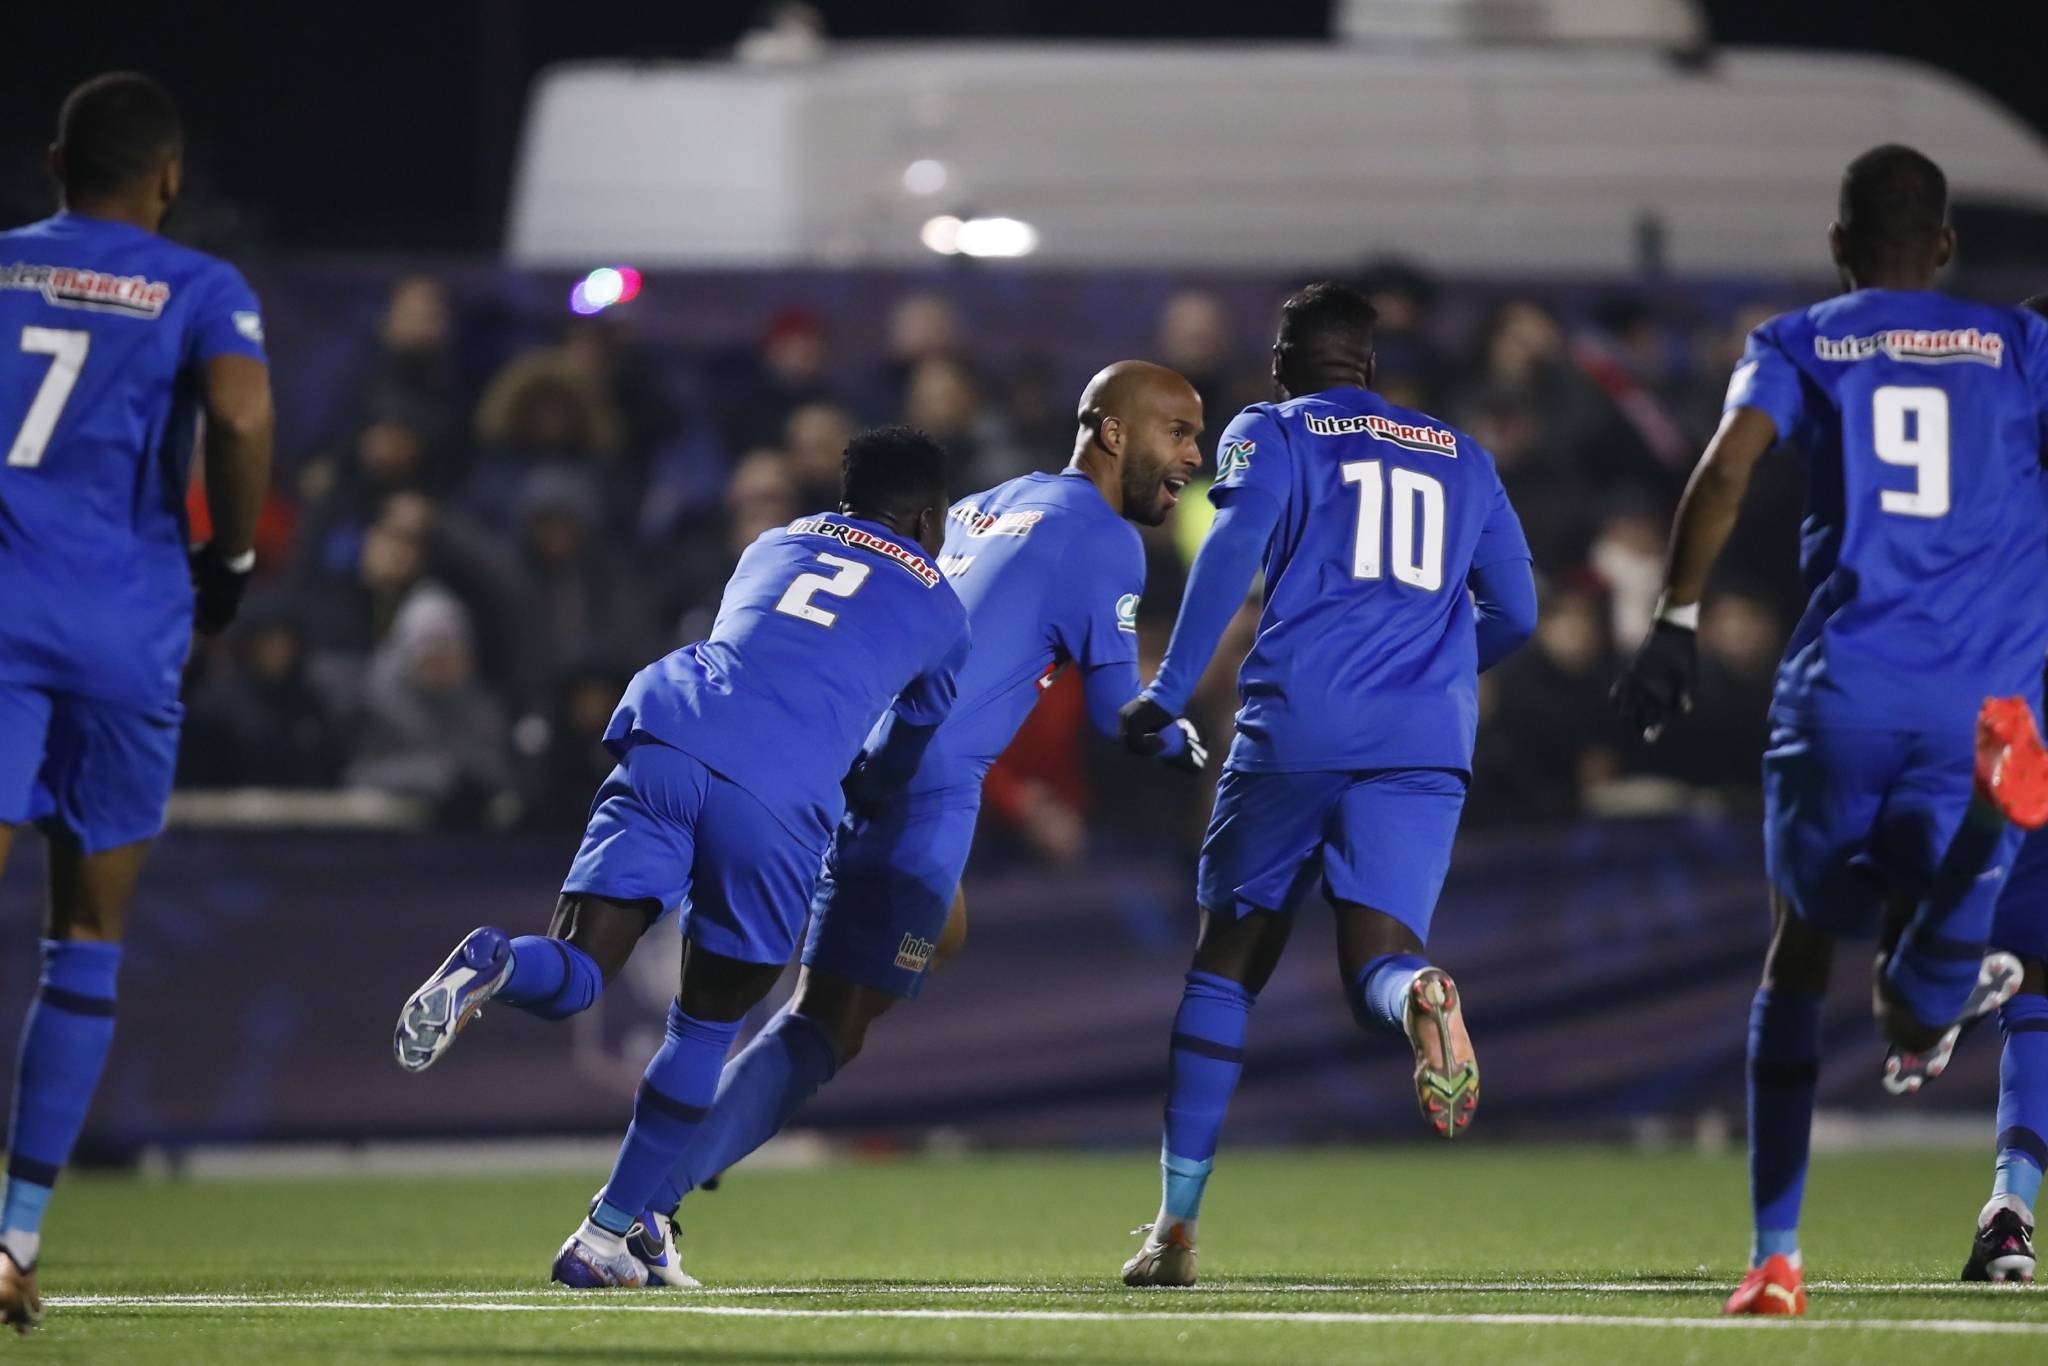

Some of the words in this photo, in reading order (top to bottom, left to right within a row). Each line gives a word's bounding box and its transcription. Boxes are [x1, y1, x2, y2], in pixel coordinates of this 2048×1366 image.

[7, 325, 90, 467] 7
[1872, 385, 1950, 519] 9
[775, 552, 873, 629] 2
[1342, 460, 1445, 592] 10
[899, 932, 935, 959] Inter
